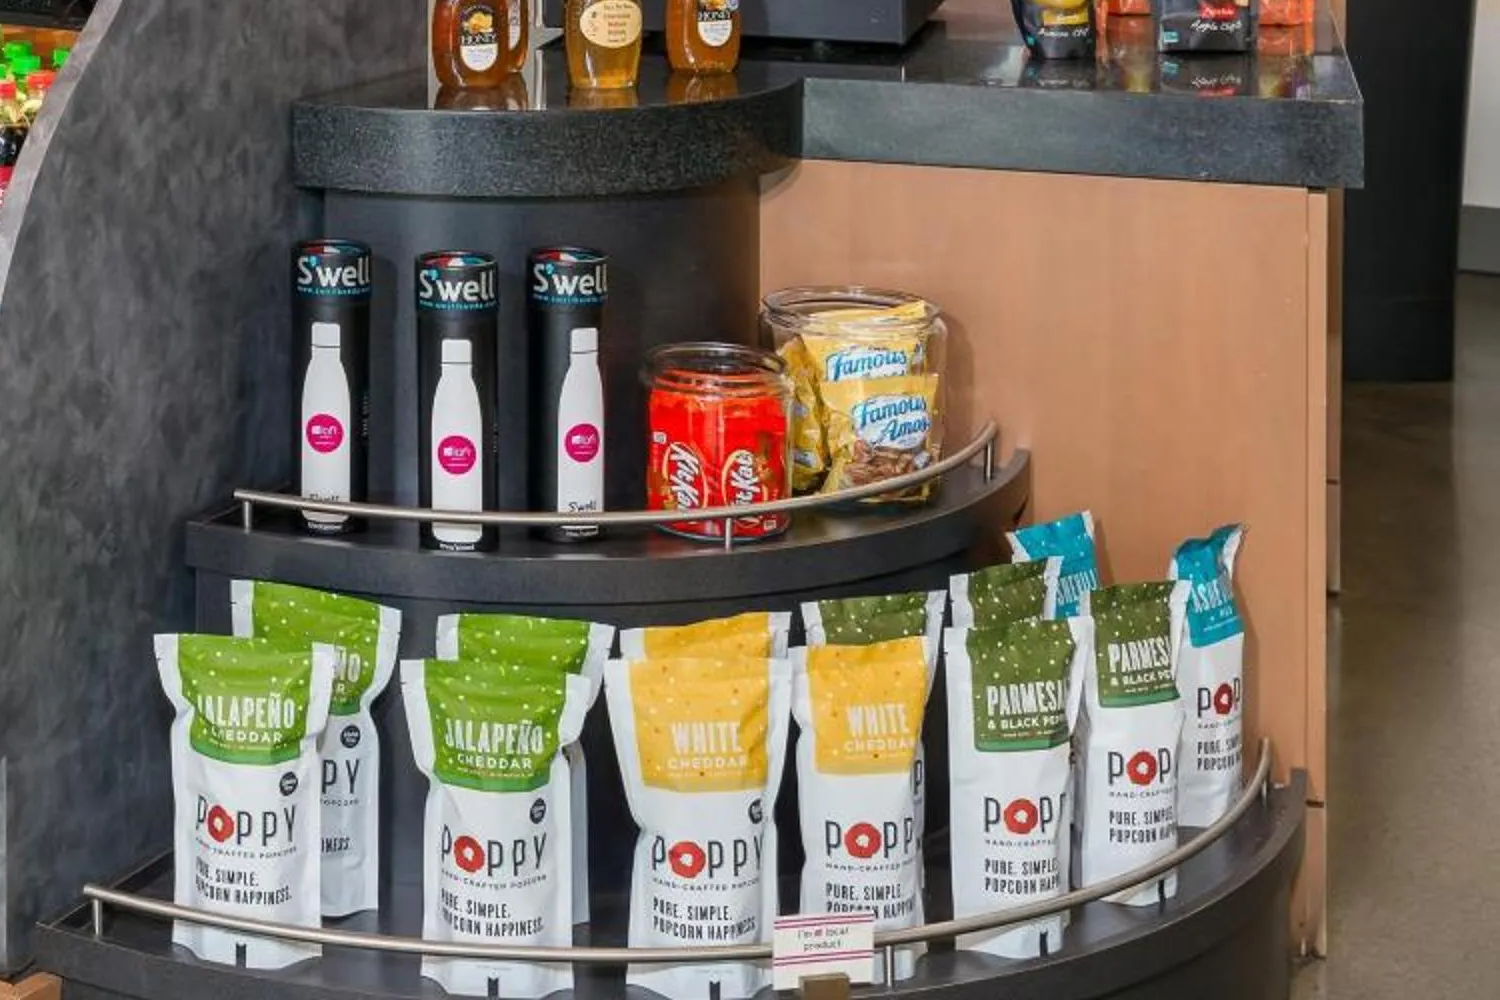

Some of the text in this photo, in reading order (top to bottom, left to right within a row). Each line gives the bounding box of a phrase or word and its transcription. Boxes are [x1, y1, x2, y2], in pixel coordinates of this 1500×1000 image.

[297, 255, 370, 286] S'well
[419, 268, 494, 301] S'well
[532, 263, 608, 295] S'well
[826, 350, 908, 382] Famous
[852, 396, 928, 430] Famous
[882, 417, 932, 441] Amos
[1108, 636, 1171, 673] PARMES
[1122, 672, 1156, 686] BLACK
[986, 680, 1069, 717] PARMESA
[1197, 677, 1241, 718] POP
[845, 703, 910, 738] WHITE
[1000, 715, 1040, 730] BLACK
[444, 718, 545, 755] JALAPEÑO
[670, 720, 743, 754] WHITE
[457, 753, 533, 770] CHEDDAR
[668, 756, 748, 770] CHEDDAR
[1108, 747, 1172, 786] POP
[195, 794, 296, 848] POPPY
[1109, 810, 1141, 828] PURE.
[440, 823, 547, 877] POPPY
[825, 816, 914, 858] POPP
[1109, 827, 1157, 844] POPCORN
[651, 834, 765, 879] POPPY
[985, 857, 1017, 875] PURE.
[215, 868, 260, 888] SIMPLE.
[825, 882, 859, 901] PURE.
[985, 876, 1037, 896] POPCORN
[466, 898, 512, 919] SIMPLE.
[653, 896, 733, 921] PURE. SIMPLE.
[652, 915, 704, 940] POPCORN
[803, 940, 842, 952] product
